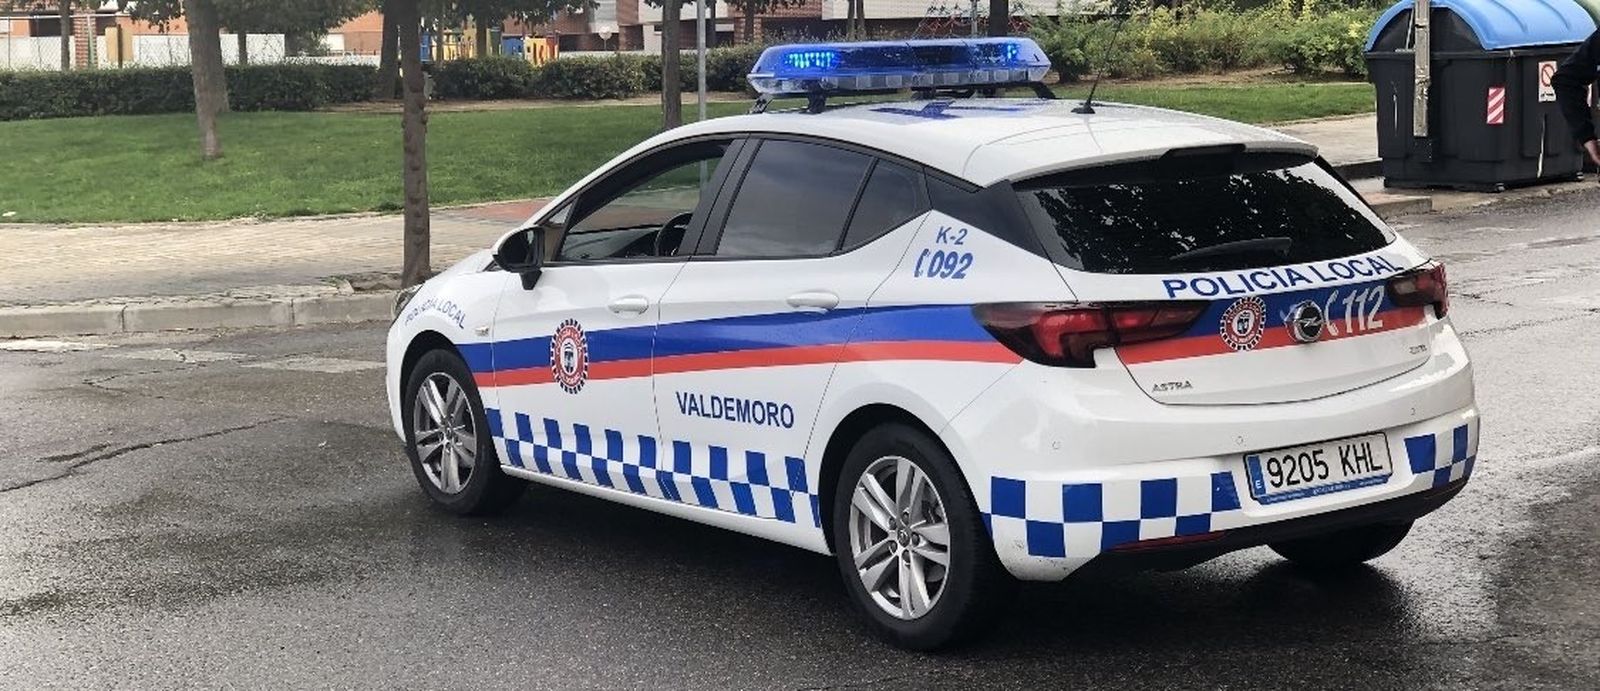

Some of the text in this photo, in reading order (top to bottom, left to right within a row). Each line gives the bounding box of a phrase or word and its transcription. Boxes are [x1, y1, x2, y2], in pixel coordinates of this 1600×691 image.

[936, 226, 968, 245] K-2
[927, 250, 974, 279] 092
[1163, 255, 1404, 298] POLICIA LOCAL
[436, 299, 466, 330] LOCAL
[1342, 285, 1385, 333] 112
[1151, 380, 1193, 393] ASTRA
[676, 391, 795, 429] VALDEMORO
[1266, 442, 1383, 488] 9205 KHL
